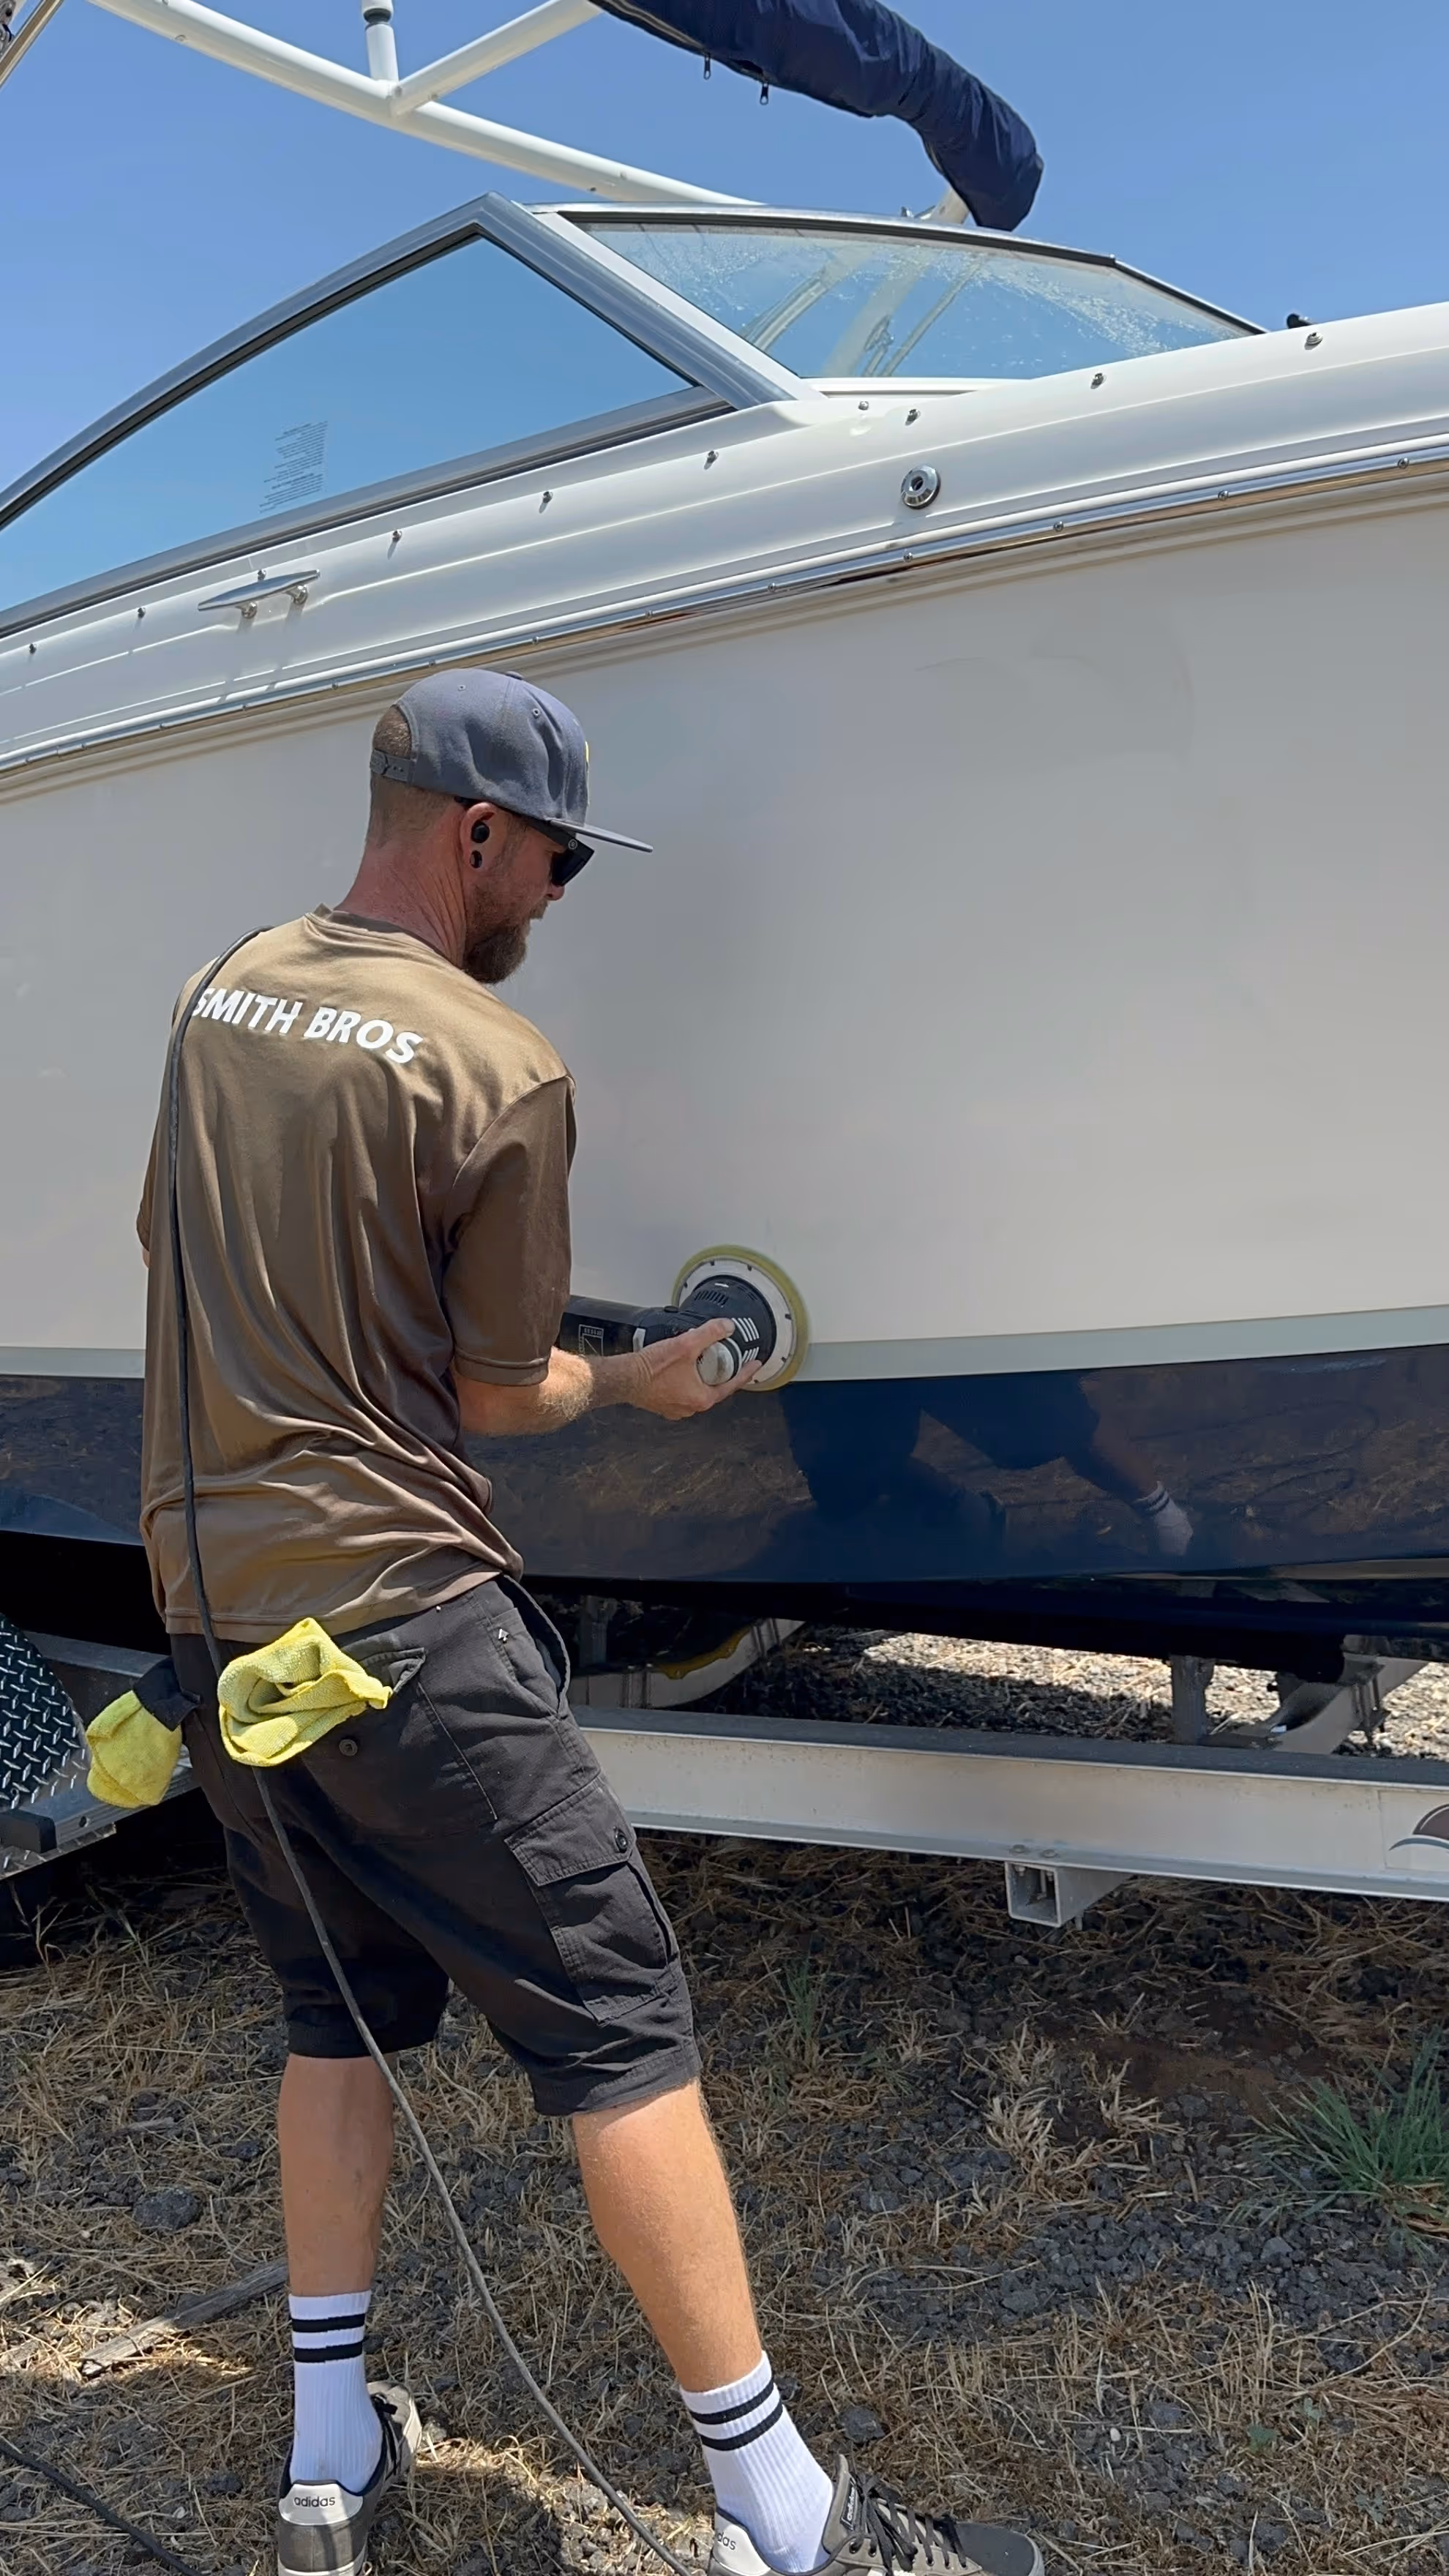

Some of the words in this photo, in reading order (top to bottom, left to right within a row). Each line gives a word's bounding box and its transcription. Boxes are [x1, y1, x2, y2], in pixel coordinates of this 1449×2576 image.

[192, 987, 304, 1036] SMITH
[304, 1006, 424, 1064] BROS
[293, 2496, 336, 2508] adidas
